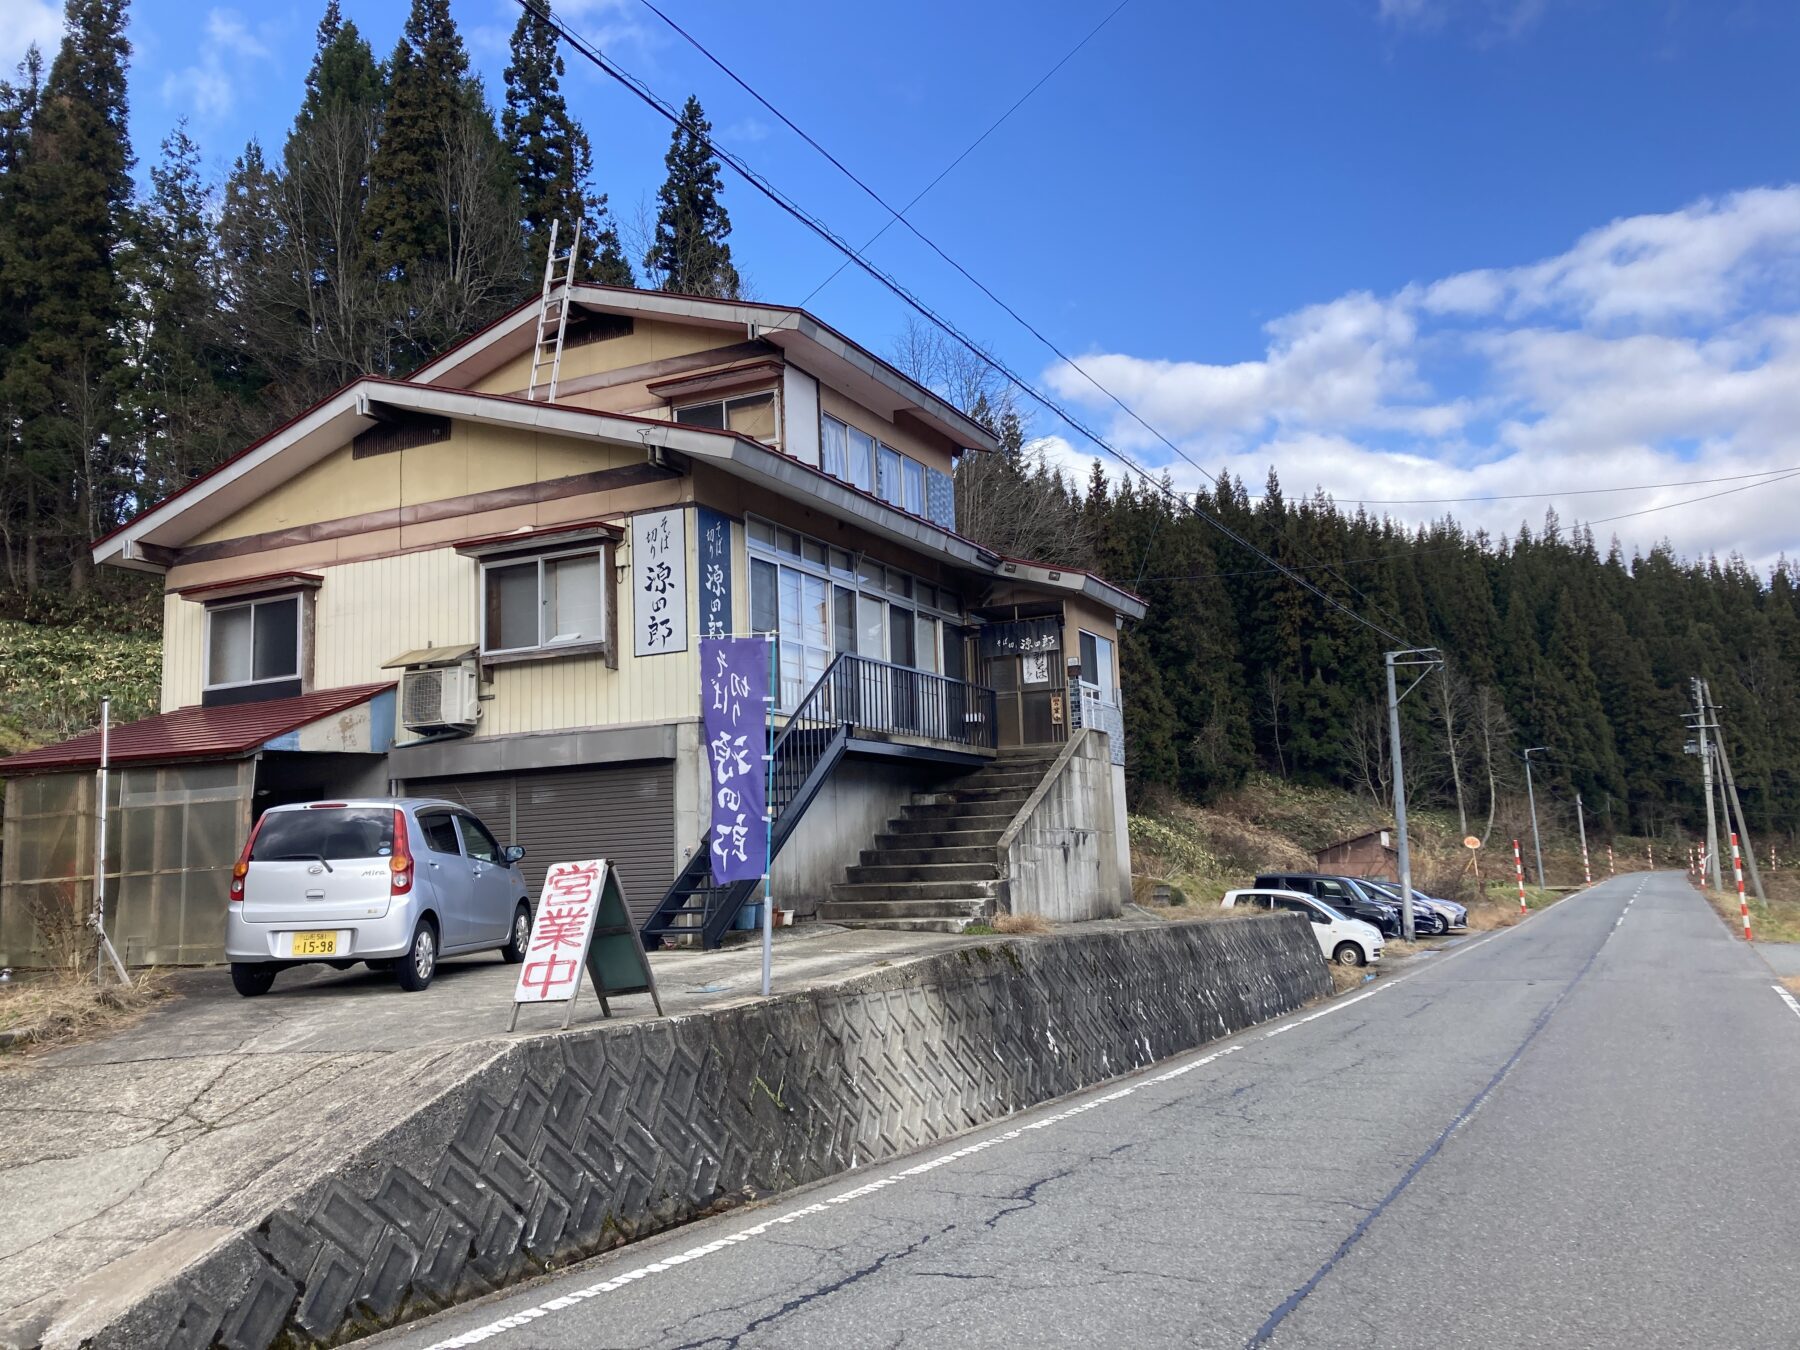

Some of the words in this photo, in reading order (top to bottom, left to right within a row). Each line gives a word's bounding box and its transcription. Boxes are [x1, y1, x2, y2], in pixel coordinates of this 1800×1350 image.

[646, 527, 657, 560] 切り
[660, 516, 671, 555] そば
[706, 528, 715, 560] 切り
[715, 520, 723, 557] そば
[644, 561, 675, 649] 源四郎
[303, 941, 333, 953] 15-98
[522, 861, 599, 1000] 営業中
